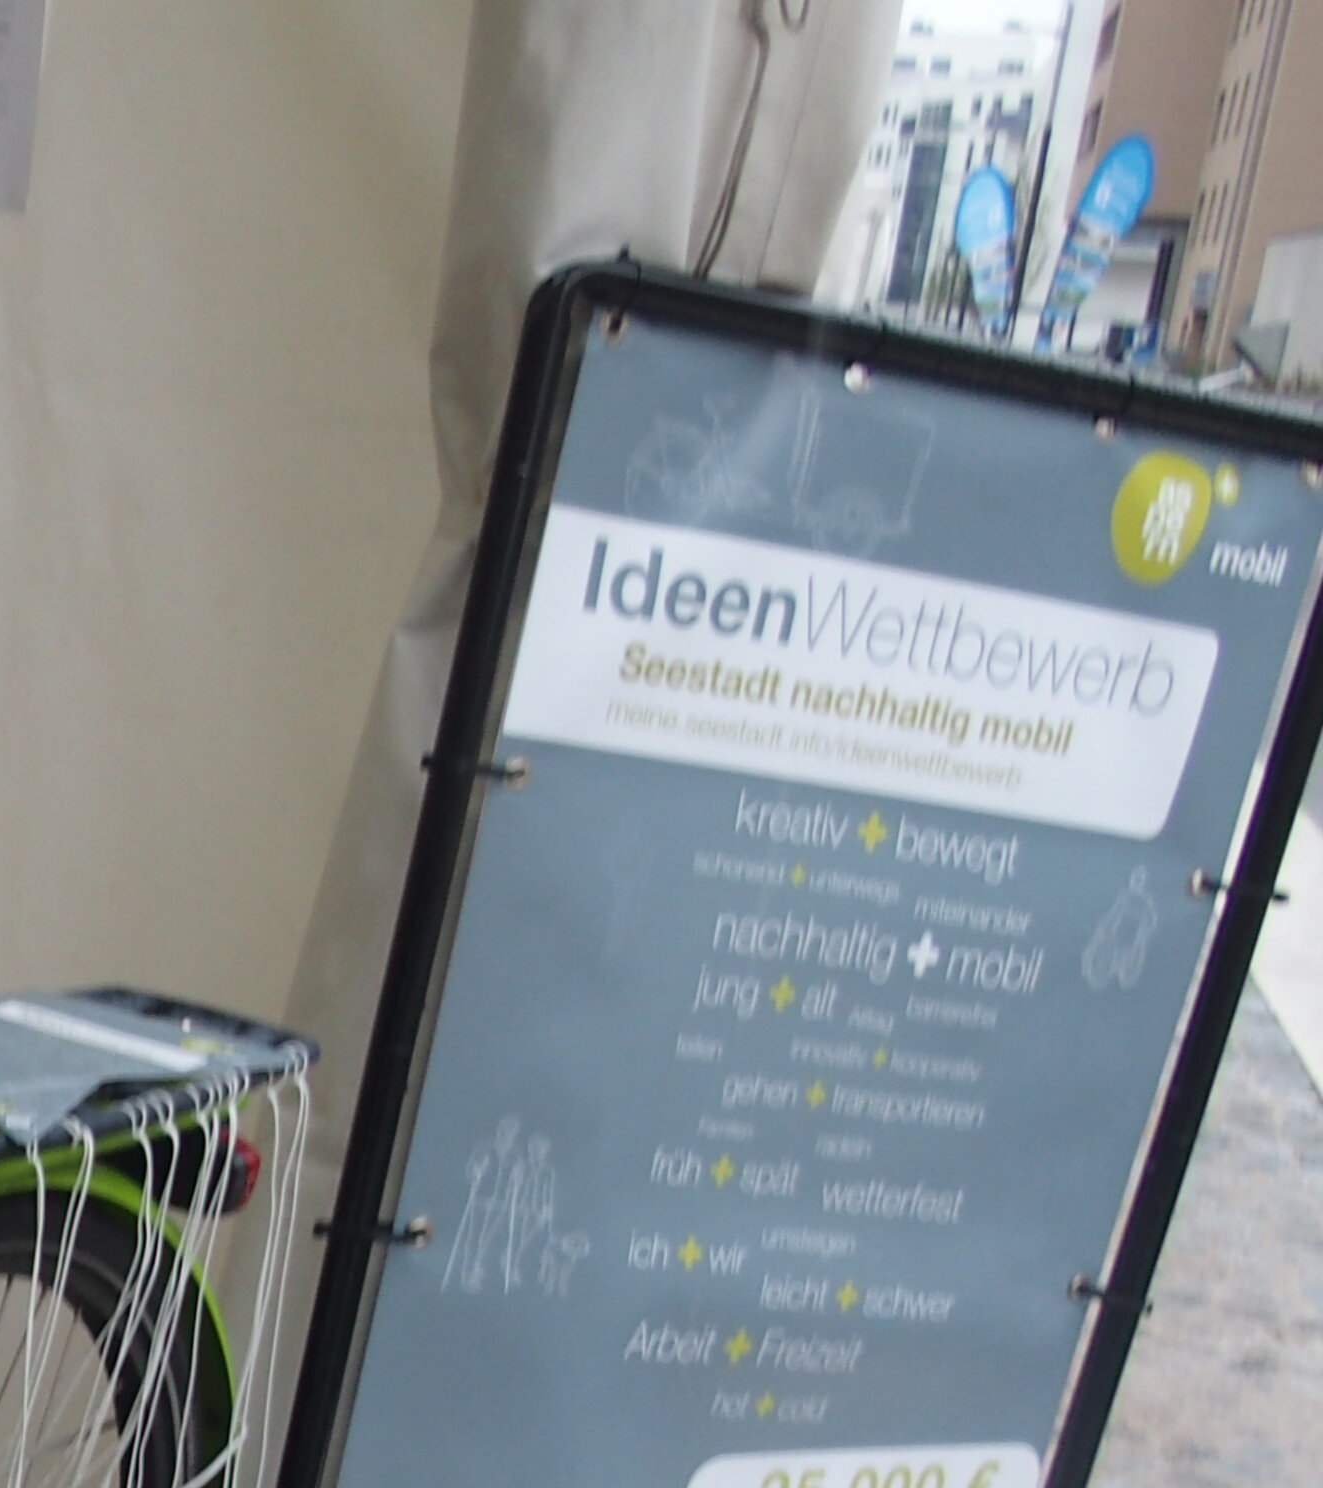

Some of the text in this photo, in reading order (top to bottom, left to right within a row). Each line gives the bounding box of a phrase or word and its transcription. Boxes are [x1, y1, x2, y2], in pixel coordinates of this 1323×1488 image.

[1209, 541, 1287, 588] mobil
[582, 534, 1175, 717] IdeenWettbewerb
[619, 640, 1076, 757] Seestadt nachhaltig mobil
[735, 787, 850, 850] kreativ
[895, 812, 1019, 886] bewegt
[713, 912, 898, 986] nachhaltig
[945, 944, 1045, 992] mobil
[692, 964, 761, 1020] jung
[801, 977, 838, 1021] alt
[821, 1179, 964, 1225] wetterfest
[709, 1239, 748, 1275] wir
[759, 1273, 829, 1313] leicht
[862, 1282, 957, 1322] schwer
[623, 1318, 718, 1367] Arbeit
[756, 1325, 864, 1374] Freizeit
